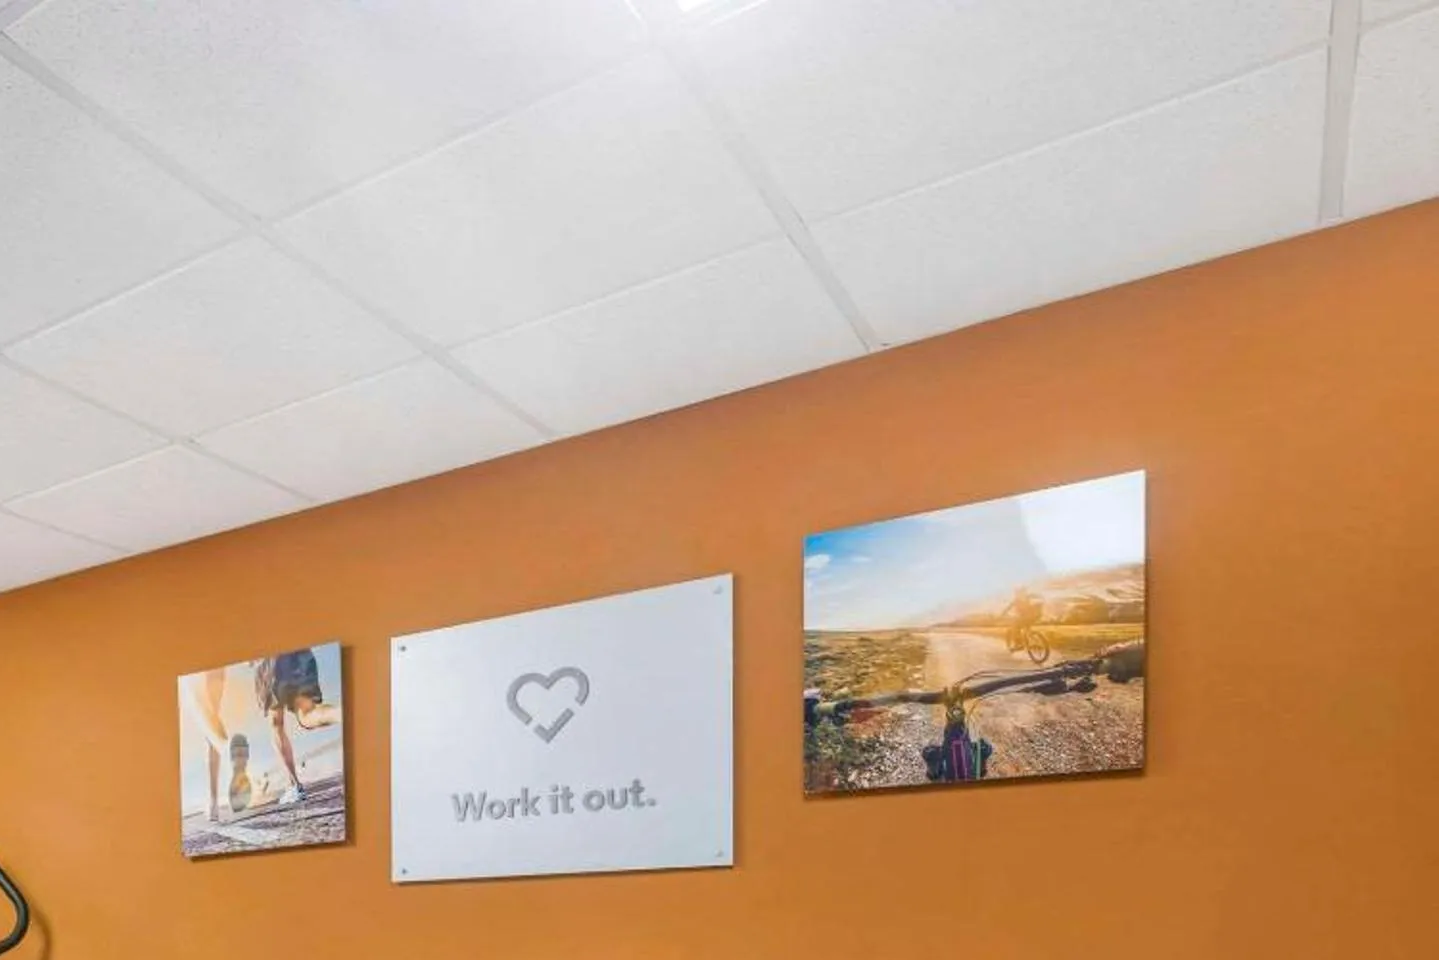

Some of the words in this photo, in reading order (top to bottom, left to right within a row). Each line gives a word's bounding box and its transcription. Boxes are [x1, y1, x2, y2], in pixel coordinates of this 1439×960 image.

[451, 787, 541, 822] Work
[550, 784, 575, 815] it
[582, 777, 658, 811] out.
